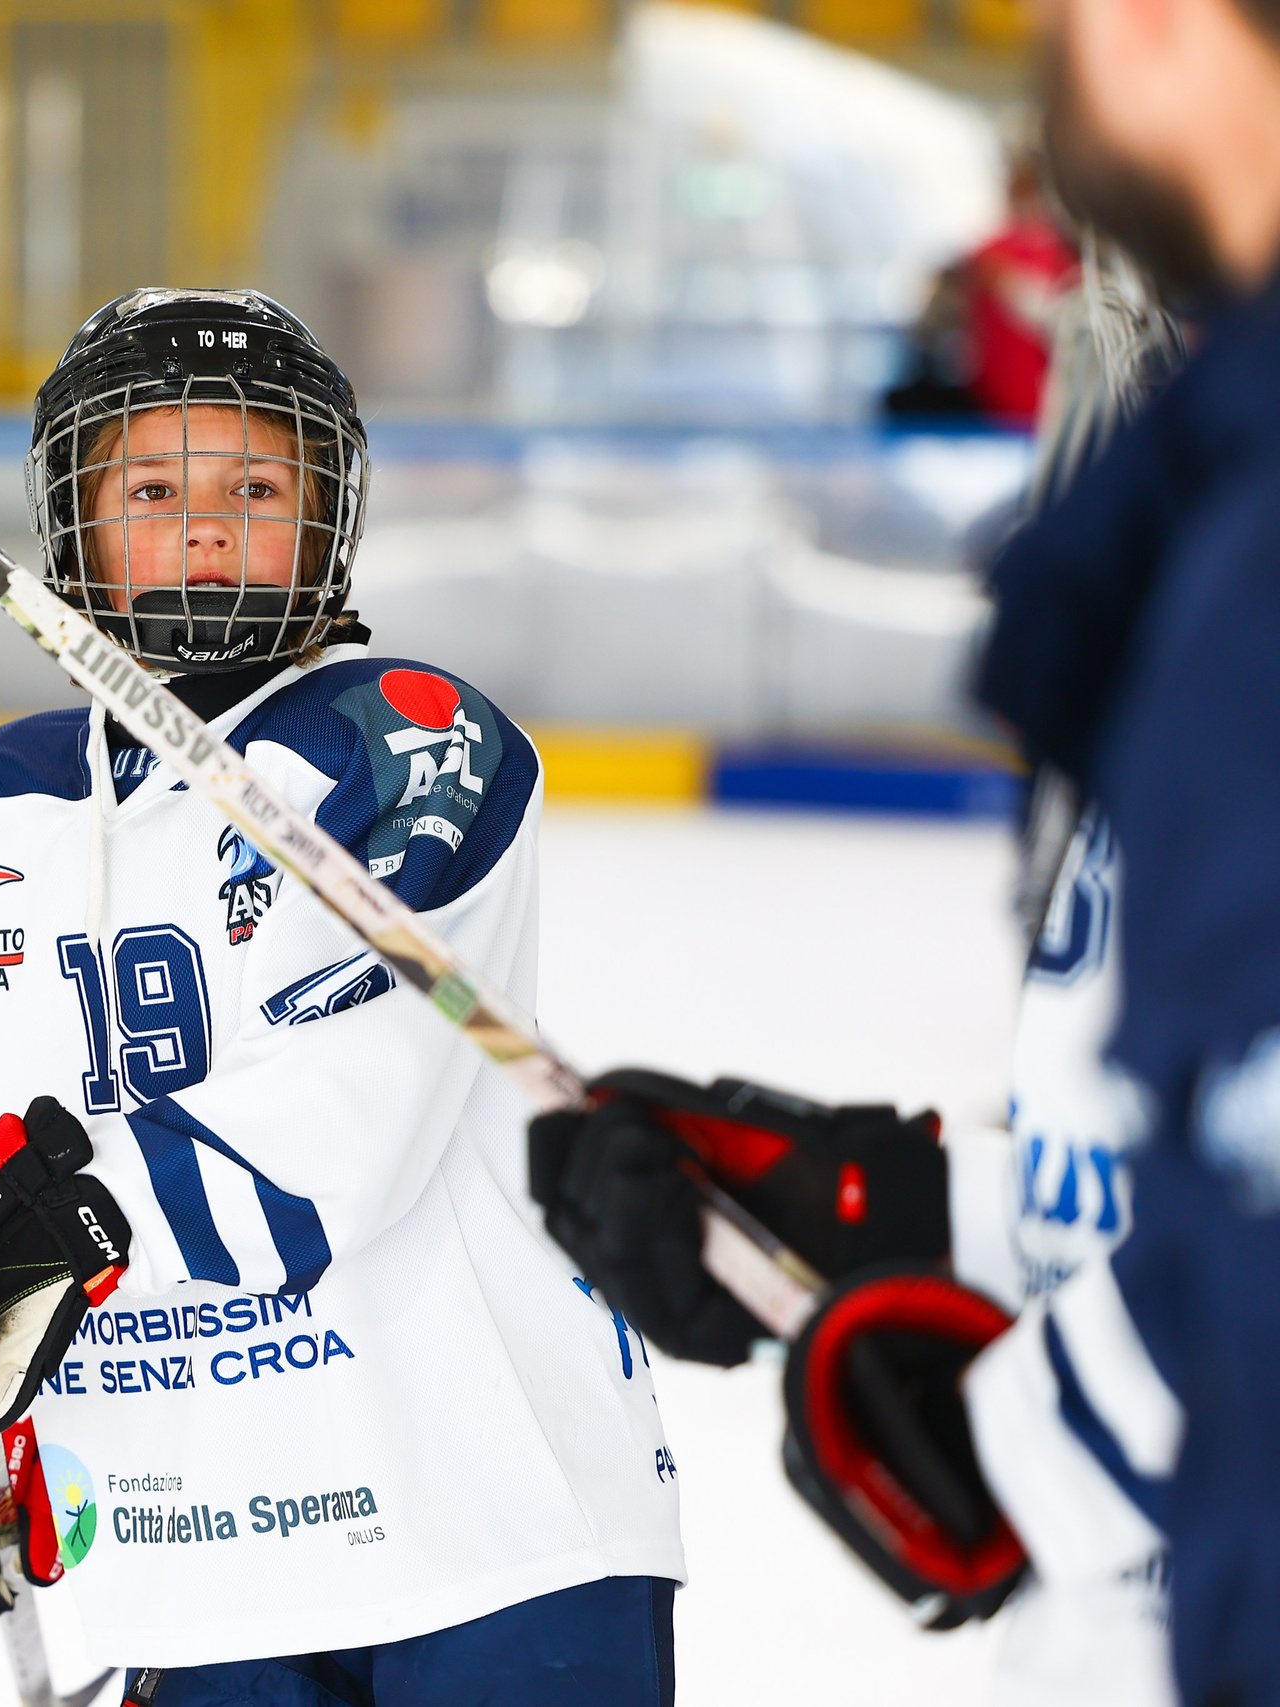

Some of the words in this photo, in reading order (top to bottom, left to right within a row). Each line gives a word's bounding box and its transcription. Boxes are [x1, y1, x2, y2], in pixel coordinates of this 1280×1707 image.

[177, 633, 255, 661] BAUER
[57, 923, 213, 1115] 19
[77, 1205, 120, 1262] CCM
[100, 1355, 196, 1394] SENZA
[108, 1472, 183, 1493] Fondazione
[113, 1505, 163, 1544] Città
[167, 1505, 239, 1543] della
[248, 1485, 379, 1538] Speranza
[347, 1526, 386, 1546] ONLUS
